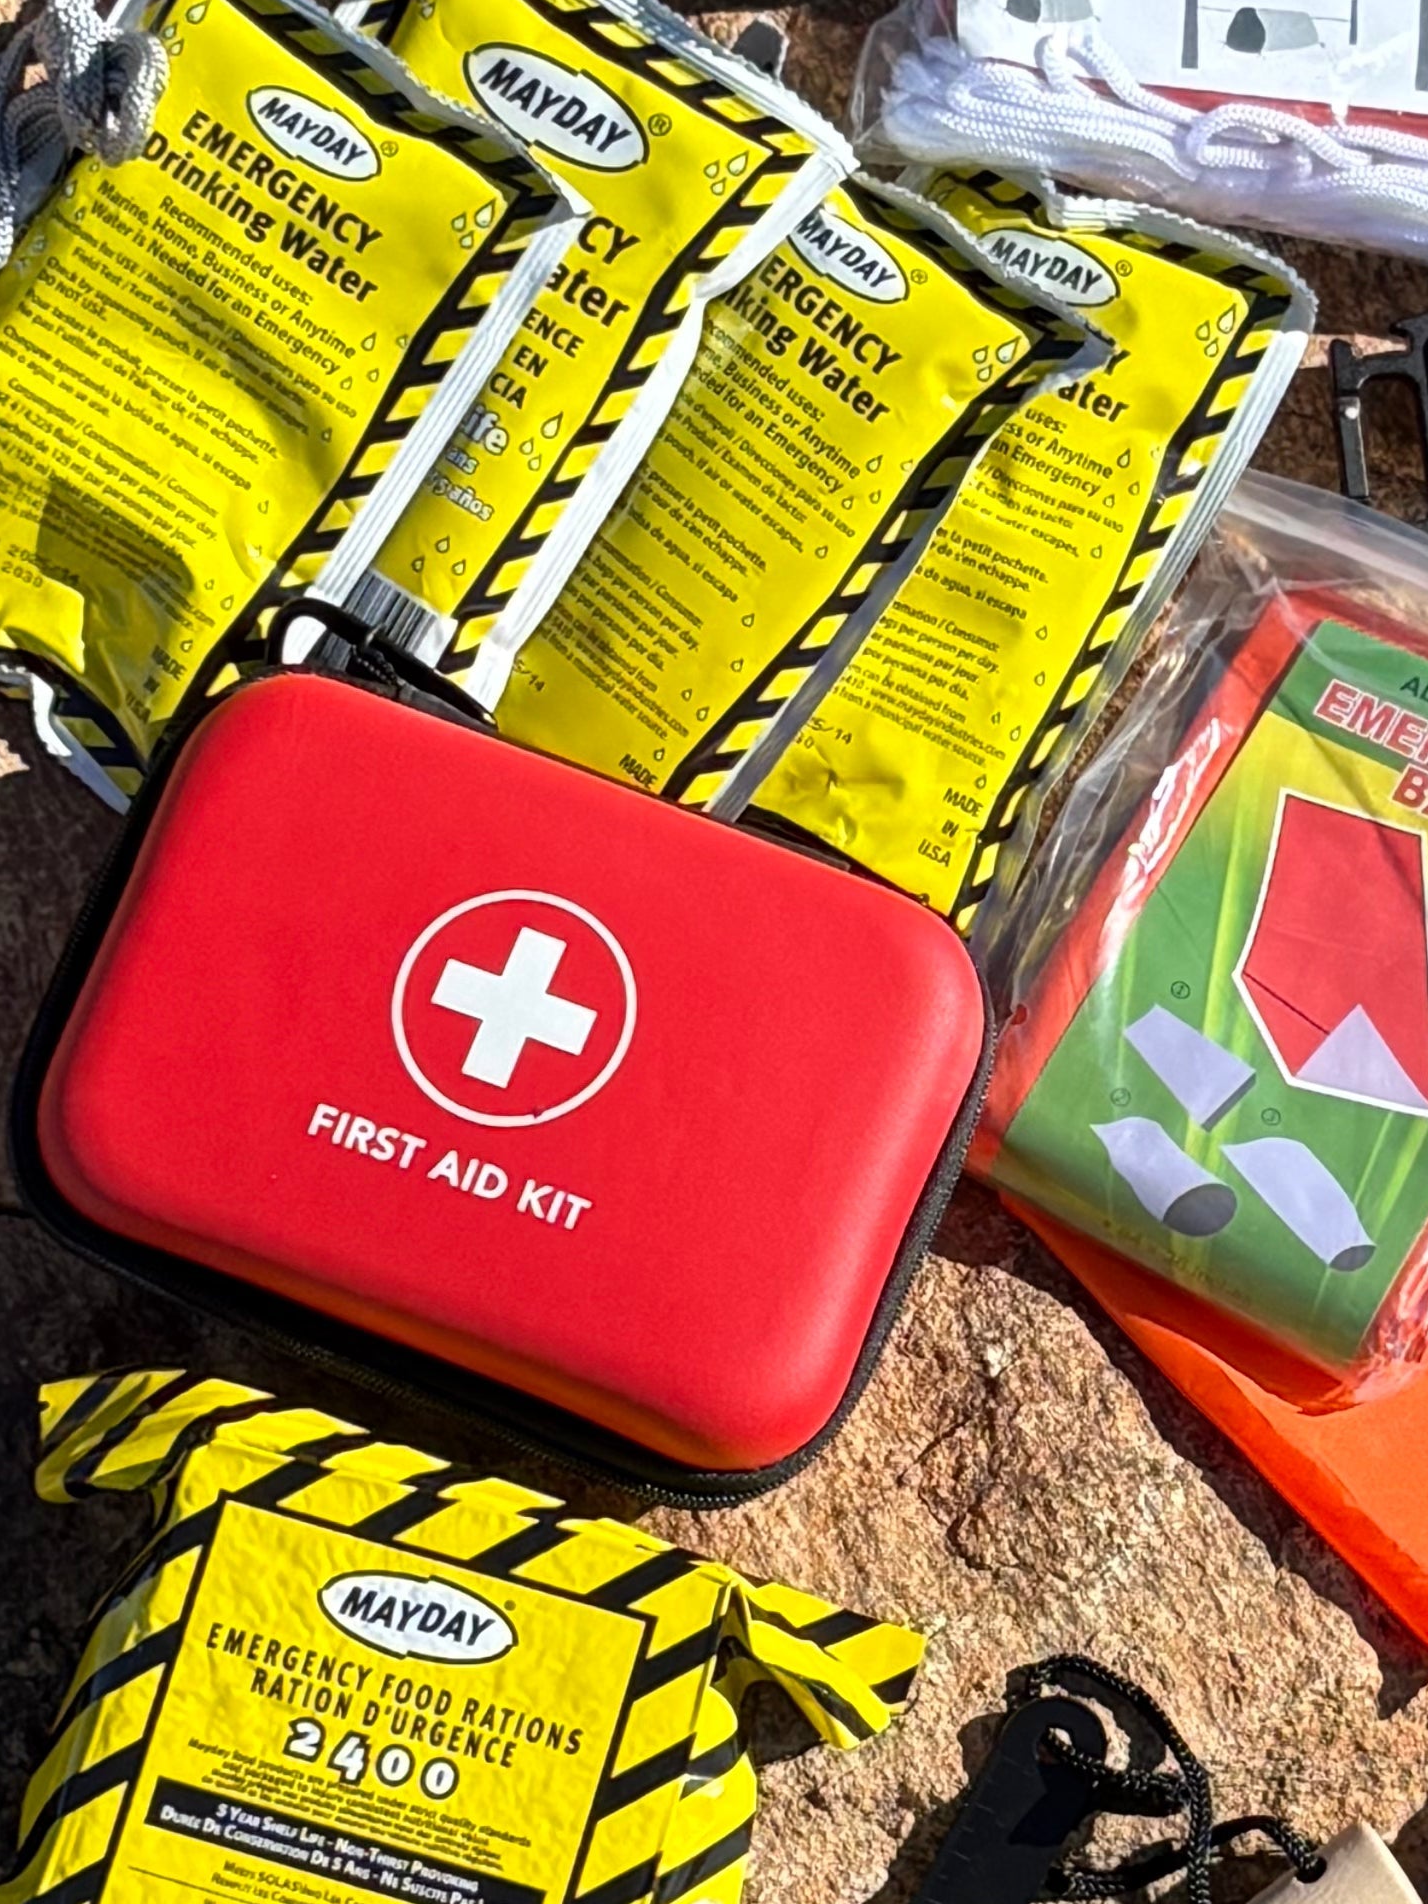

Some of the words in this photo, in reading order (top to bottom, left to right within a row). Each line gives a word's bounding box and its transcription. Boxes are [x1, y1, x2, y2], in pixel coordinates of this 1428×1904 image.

[258, 97, 367, 168] MAYDAY
[479, 60, 632, 152] MAYDAY
[142, 131, 274, 243] Drinking
[281, 220, 379, 302] Water
[181, 110, 383, 253] EMERGENCY
[90, 199, 134, 236] Water
[131, 228, 146, 247] is
[146, 238, 209, 287] Needed
[206, 279, 232, 303] for
[230, 298, 252, 318] an
[254, 311, 341, 375] Emergency
[151, 215, 198, 260] Home,
[201, 250, 269, 303] Business
[270, 299, 290, 315] or
[291, 301, 356, 358] Anytime
[158, 196, 273, 280] Recommended
[272, 271, 312, 306] uses:
[796, 211, 897, 288] MAYDAY
[990, 237, 1102, 295] MAYDAY
[543, 258, 631, 328] ater
[758, 255, 902, 374] ERGENCY
[513, 346, 549, 377] EN
[798, 338, 890, 424] Water
[463, 404, 509, 456] ife
[719, 360, 782, 416] Business
[781, 412, 800, 429] or
[797, 424, 866, 479] Anytime
[786, 388, 825, 423] uses:
[1025, 407, 1066, 434] uses:
[1059, 379, 1130, 423] ater
[722, 388, 746, 412] for
[743, 409, 764, 429] an
[763, 422, 844, 494] Emergency
[1007, 444, 1101, 497] Emergency
[1025, 431, 1045, 447] or
[1044, 437, 1113, 479] Anytime
[619, 754, 658, 790] MADE
[942, 787, 983, 818] MADE
[941, 819, 959, 839] IN
[307, 1103, 427, 1170] FIRST
[428, 1150, 508, 1199] AID
[516, 1179, 593, 1230] KIT
[339, 1587, 495, 1648] MAYDAY
[205, 1622, 373, 1692] EMERGENCY
[379, 1673, 452, 1716] FOOD
[461, 1697, 583, 1755] RATIONS
[250, 1667, 353, 1720] RATION
[362, 1700, 517, 1768] D'URGENCE
[283, 1716, 459, 1799] 2400
